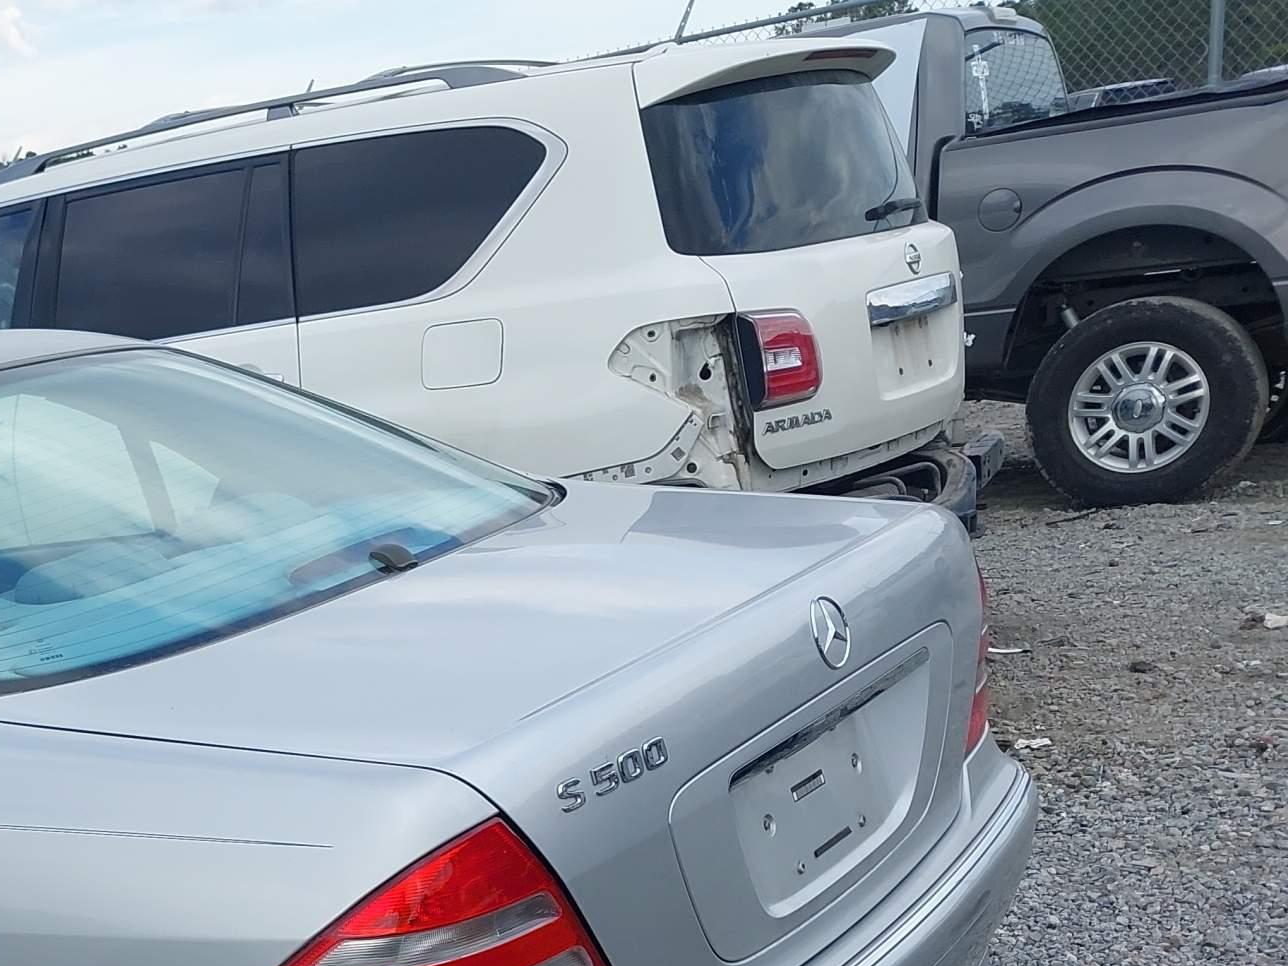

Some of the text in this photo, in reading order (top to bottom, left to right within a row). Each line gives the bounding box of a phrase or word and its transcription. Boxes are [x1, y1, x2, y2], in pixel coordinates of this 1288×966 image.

[762, 408, 833, 436] ARMADA
[557, 736, 669, 813] S 500
